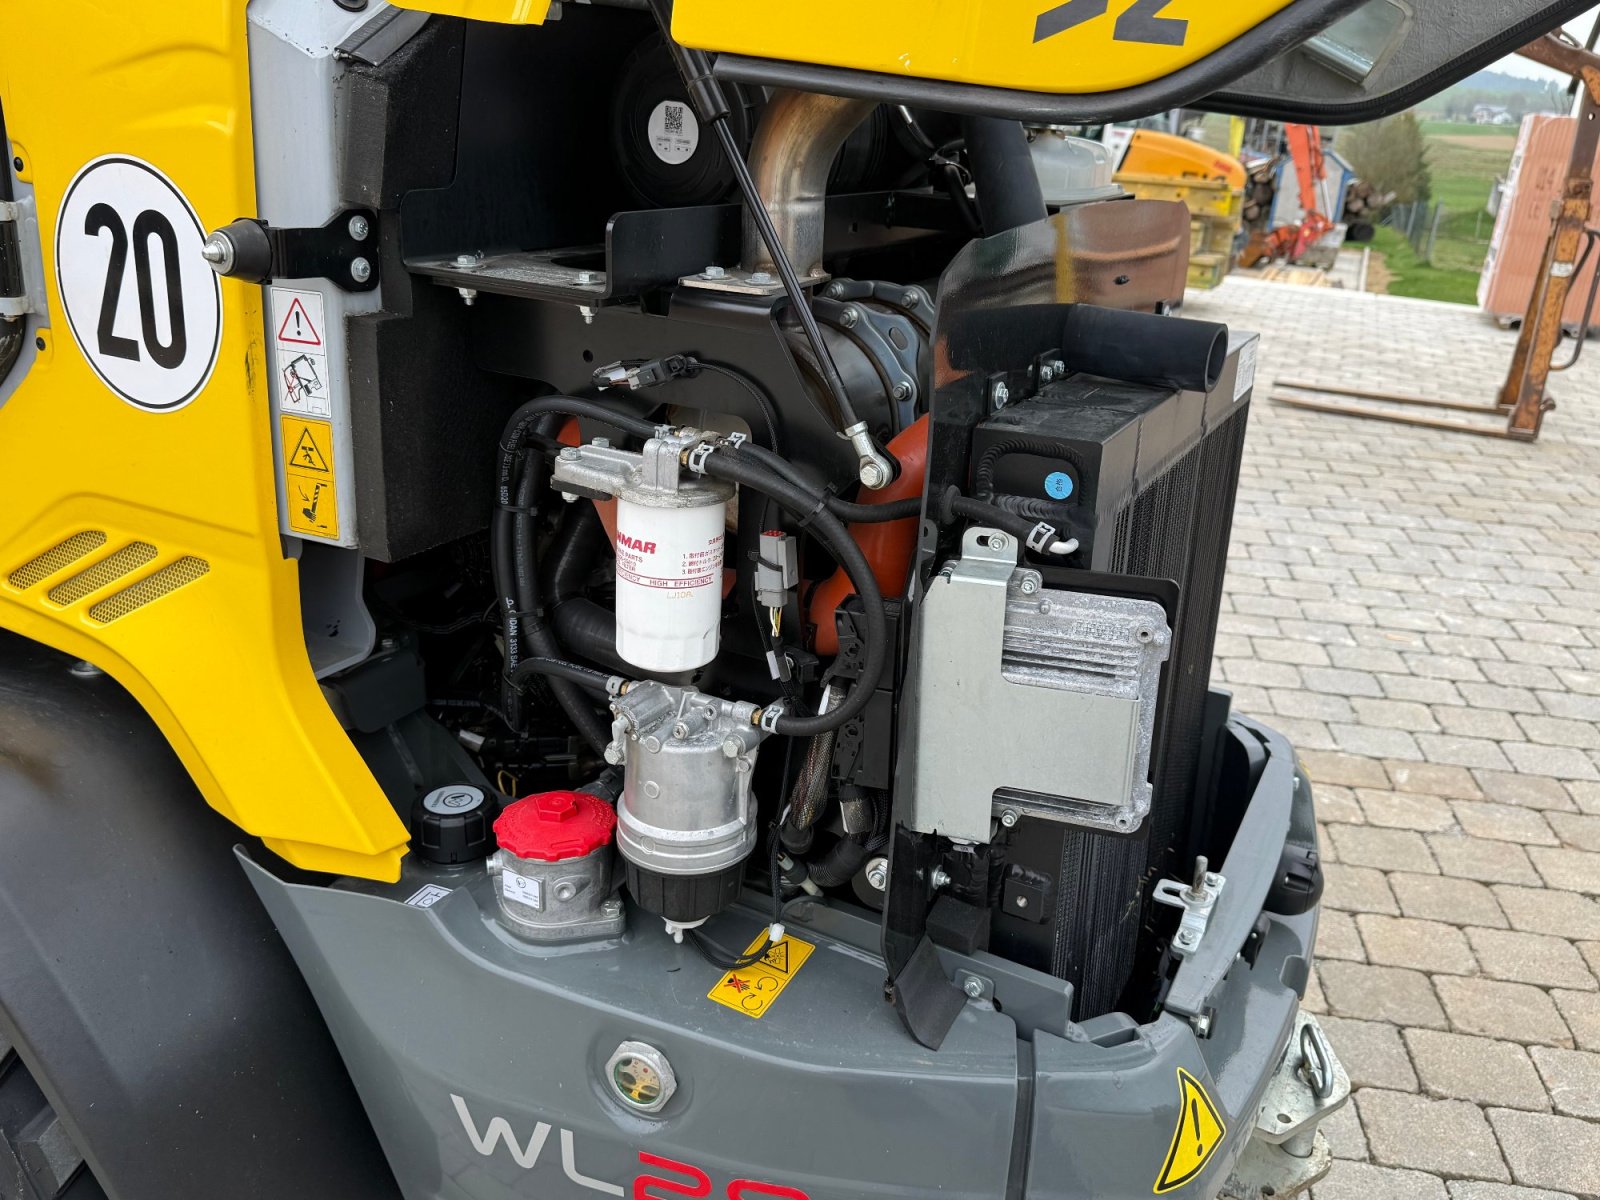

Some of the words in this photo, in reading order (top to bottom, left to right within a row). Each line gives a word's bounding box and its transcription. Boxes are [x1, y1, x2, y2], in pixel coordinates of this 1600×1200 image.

[84, 202, 187, 370] 20
[649, 579, 668, 587] HIGH
[674, 577, 713, 587] EFFICIENCY
